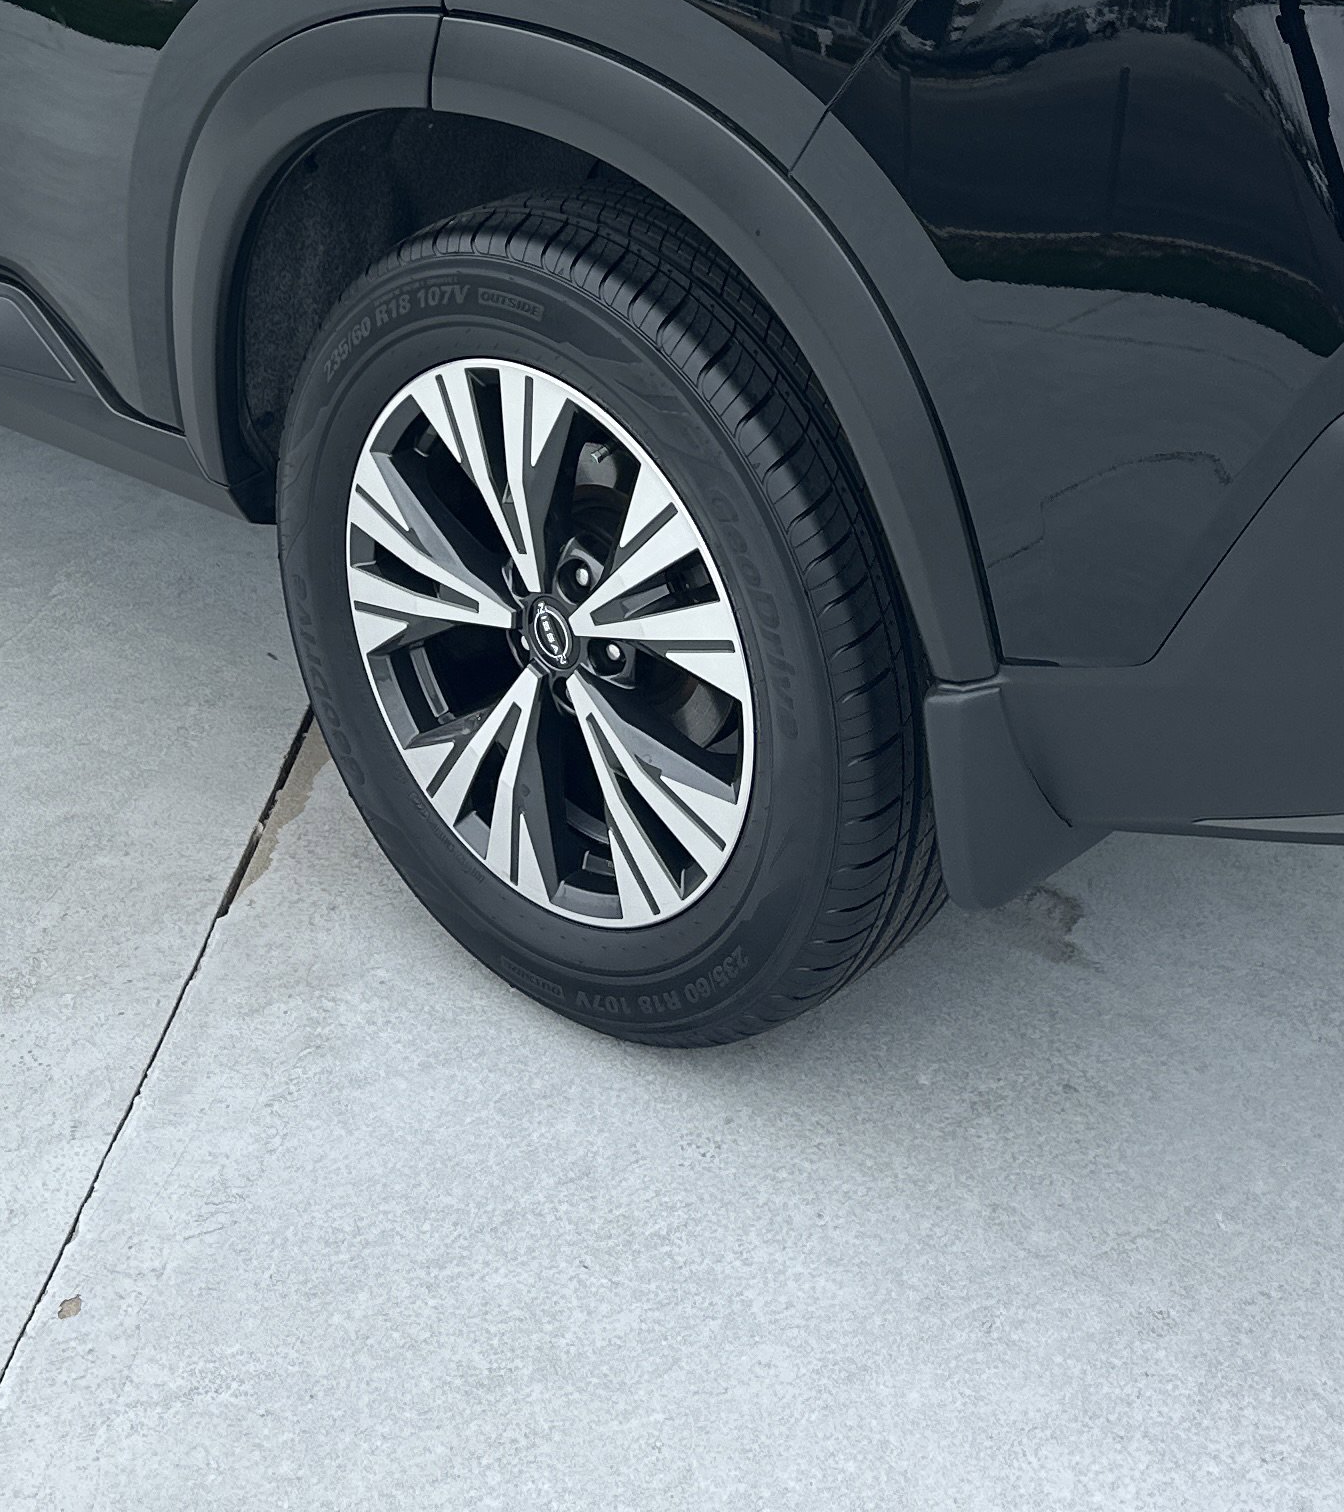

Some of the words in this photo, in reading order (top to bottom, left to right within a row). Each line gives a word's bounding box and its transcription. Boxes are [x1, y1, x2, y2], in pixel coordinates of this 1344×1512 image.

[323, 316, 372, 383] 235/60
[375, 294, 411, 327] R18
[416, 285, 471, 308] 107V
[482, 292, 541, 317] OUTSIDE
[683, 944, 750, 1003] 235/60
[575, 990, 632, 1015] 107V
[637, 991, 682, 1014] R18
